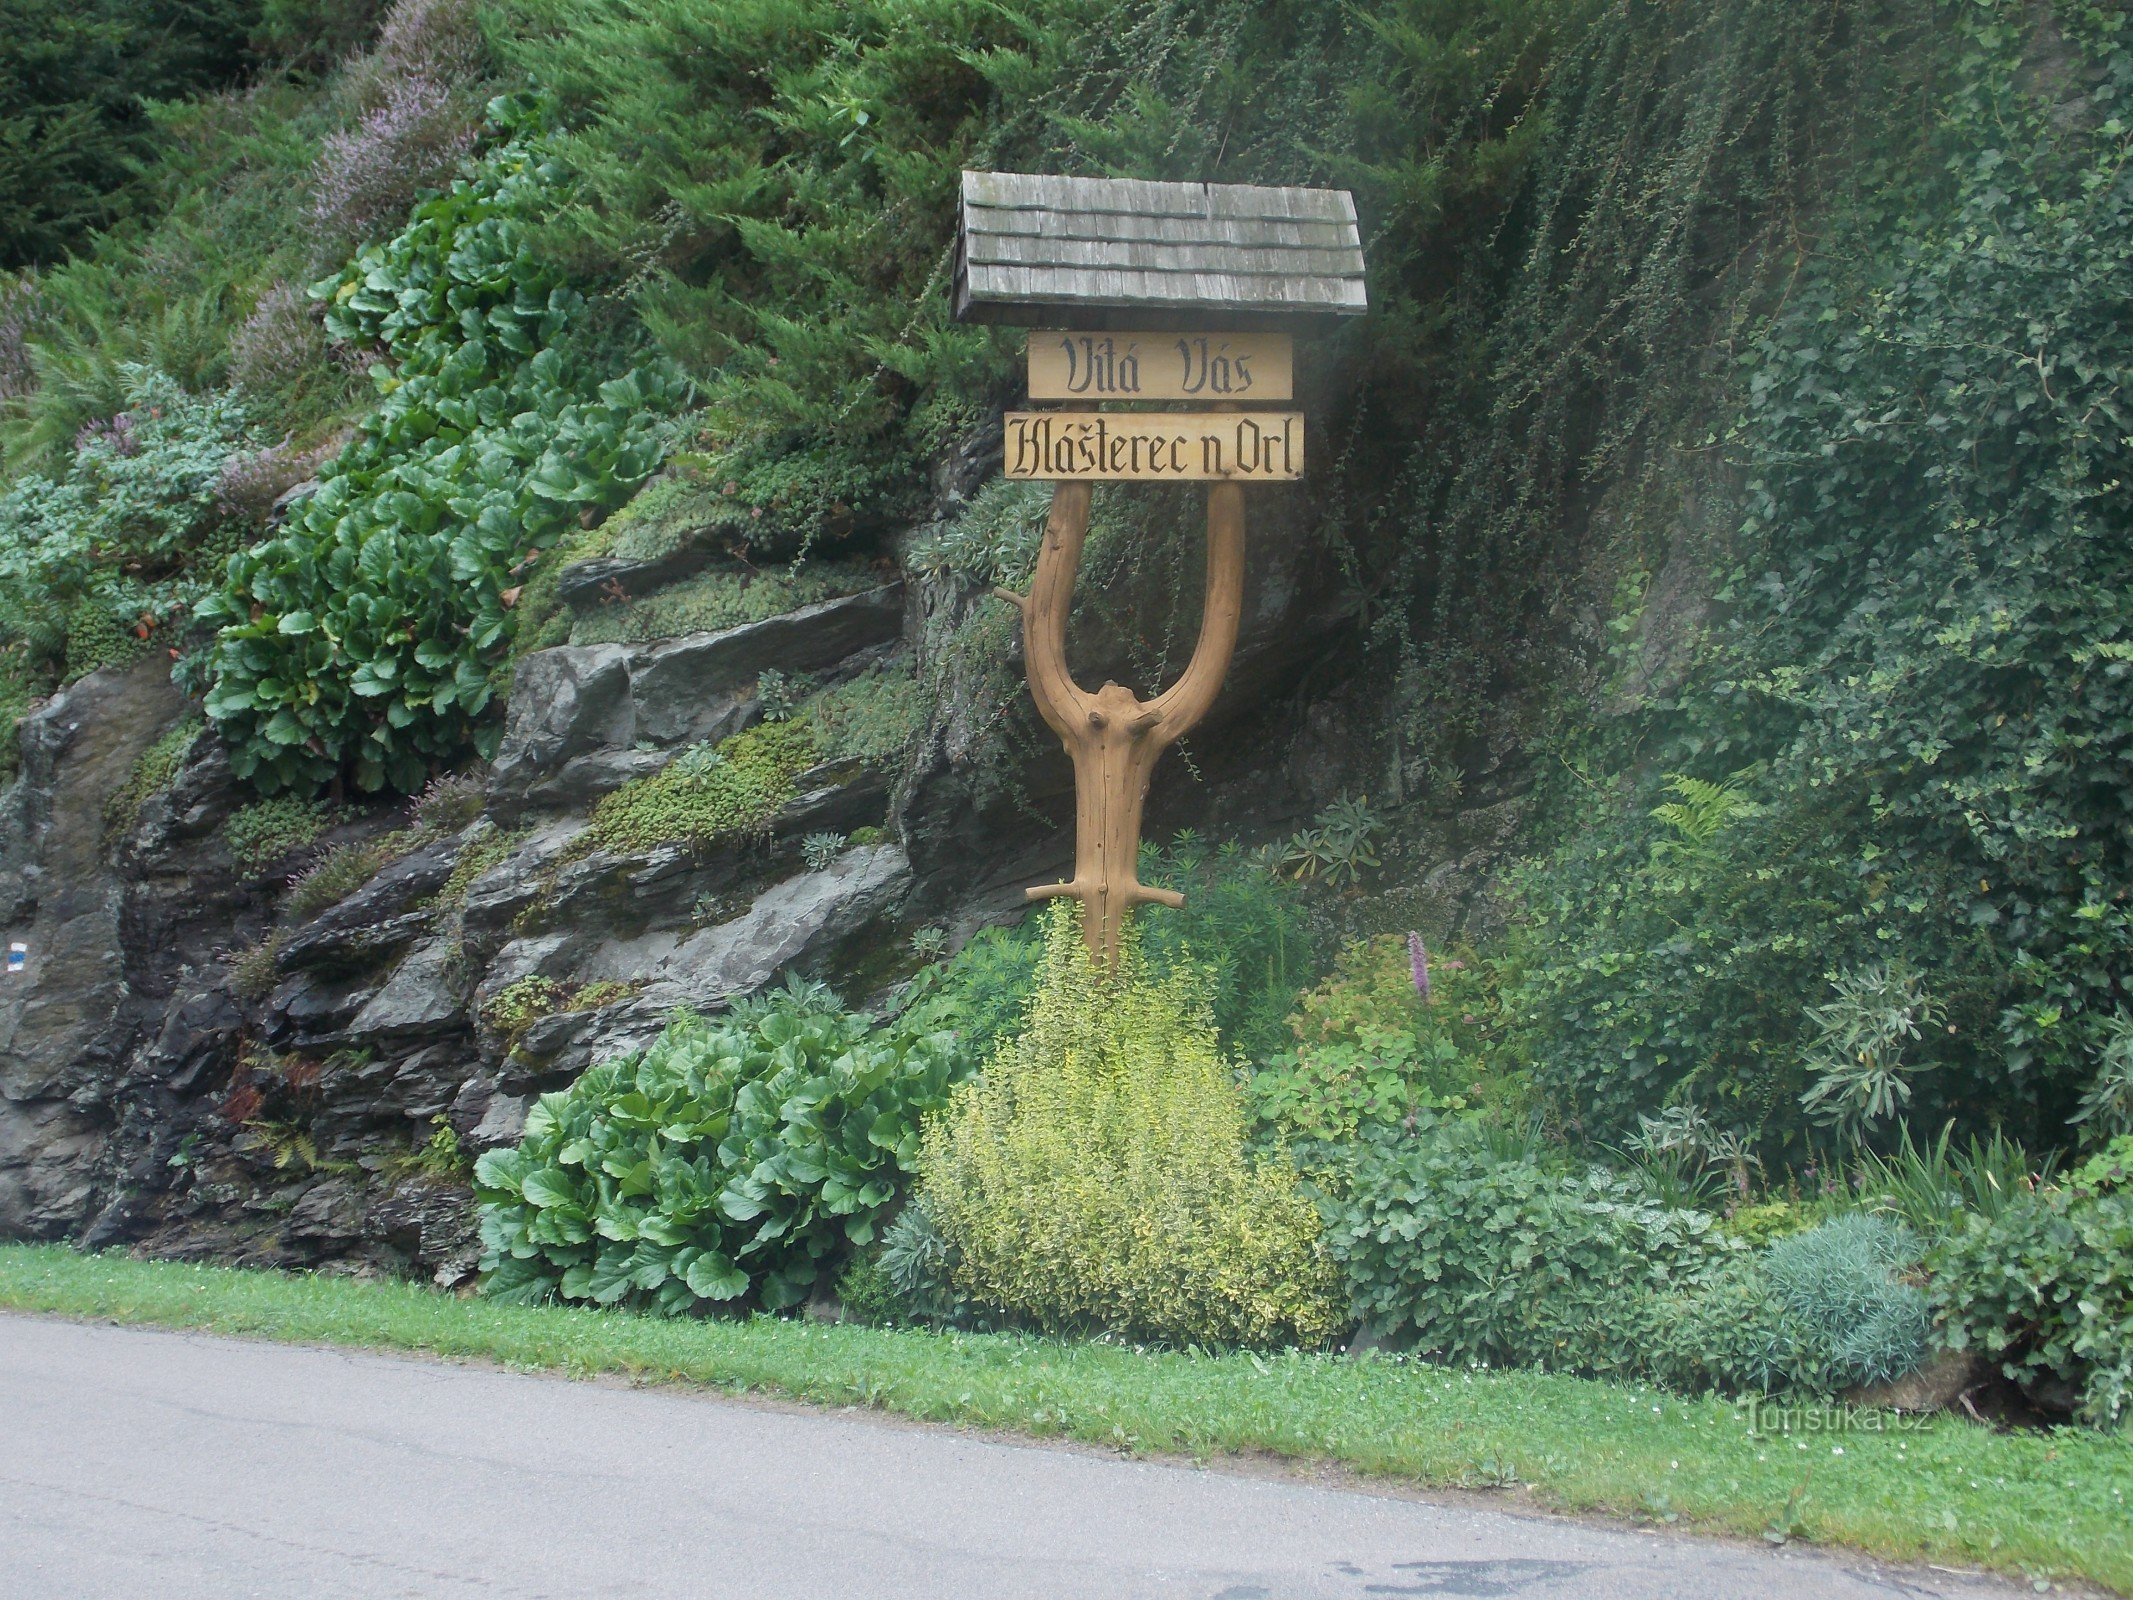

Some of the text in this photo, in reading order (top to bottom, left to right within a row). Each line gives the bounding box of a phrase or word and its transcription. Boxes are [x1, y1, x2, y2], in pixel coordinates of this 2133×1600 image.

[1059, 335, 1253, 394] Vítá Vás
[1008, 417, 1188, 476] Klášterec
[1236, 417, 1301, 477] Orl.
